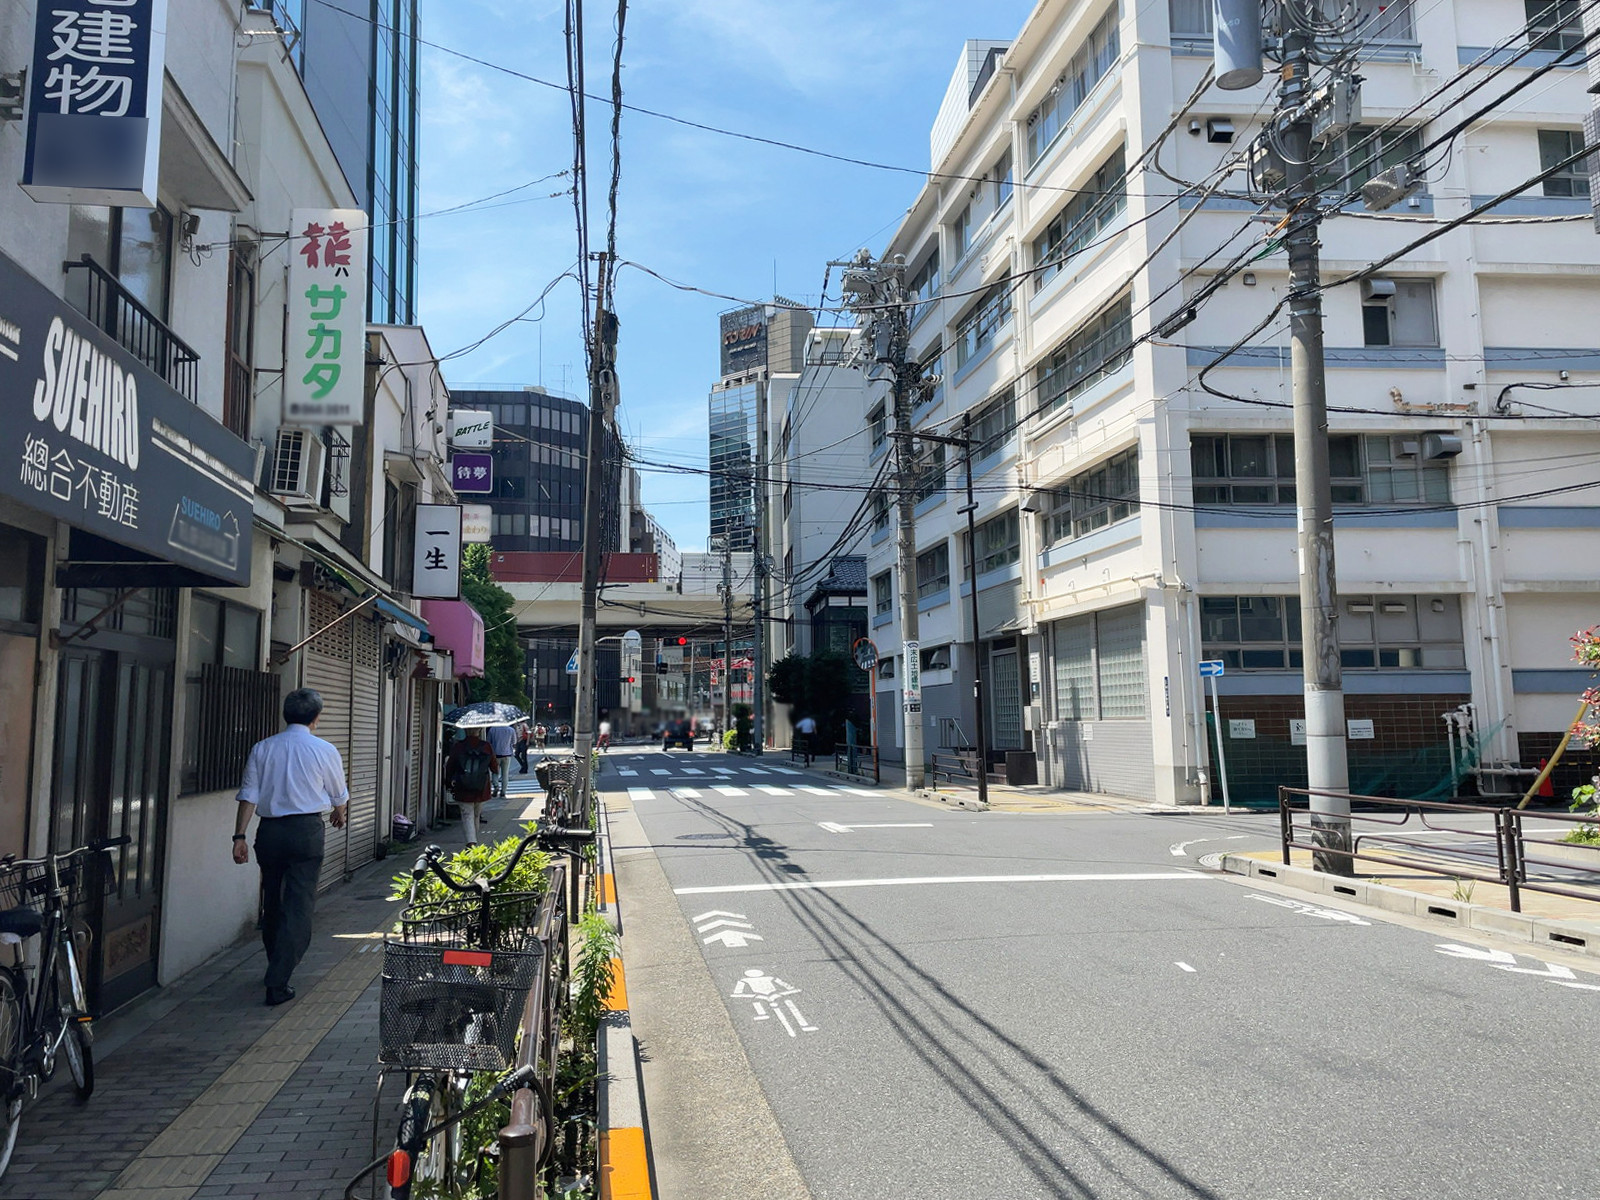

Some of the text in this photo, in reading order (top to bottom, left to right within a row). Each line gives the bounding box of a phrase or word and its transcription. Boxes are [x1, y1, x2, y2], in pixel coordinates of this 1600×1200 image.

[44, 0, 138, 117] 建物
[33, 316, 139, 471] SUEHIRO
[455, 421, 490, 437] BATTLE
[20, 432, 140, 530] 總合不動産
[181, 496, 221, 531] SUEHIRO
[424, 530, 450, 570] 一生
